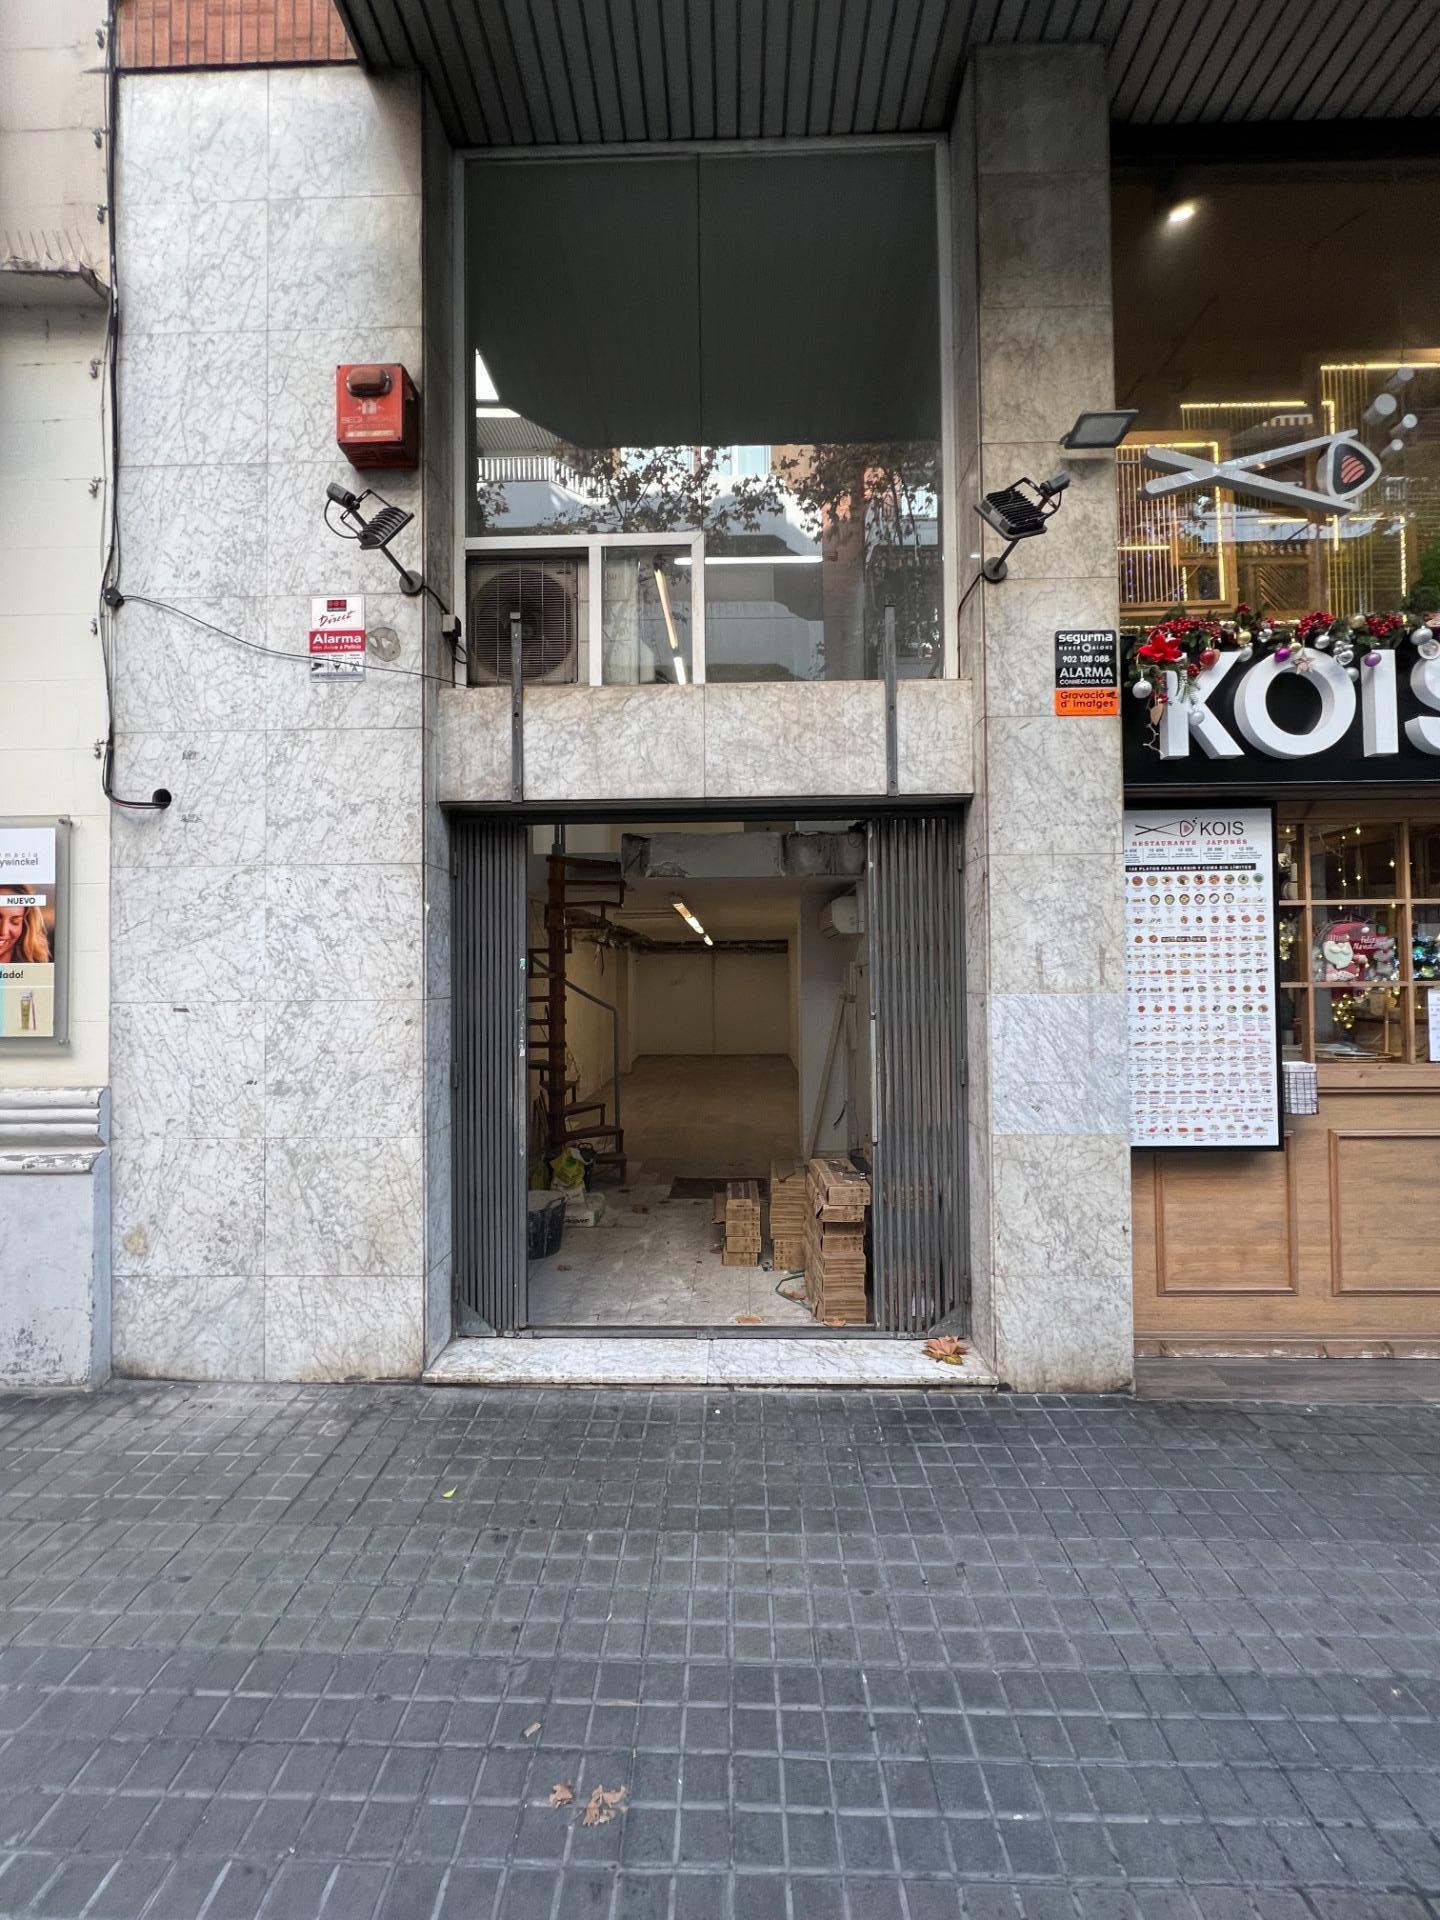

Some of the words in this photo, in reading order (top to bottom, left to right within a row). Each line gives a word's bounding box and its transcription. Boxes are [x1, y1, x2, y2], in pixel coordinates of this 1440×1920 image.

[313, 633, 362, 644] Alarma
[1058, 633, 1113, 645] segurma
[1062, 655, 1077, 663] 902
[1080, 655, 1093, 663] 108
[1059, 667, 1113, 678] ALARMA
[1060, 689, 1105, 699] Gravació
[7, 897, 36, 905] NUEVO
